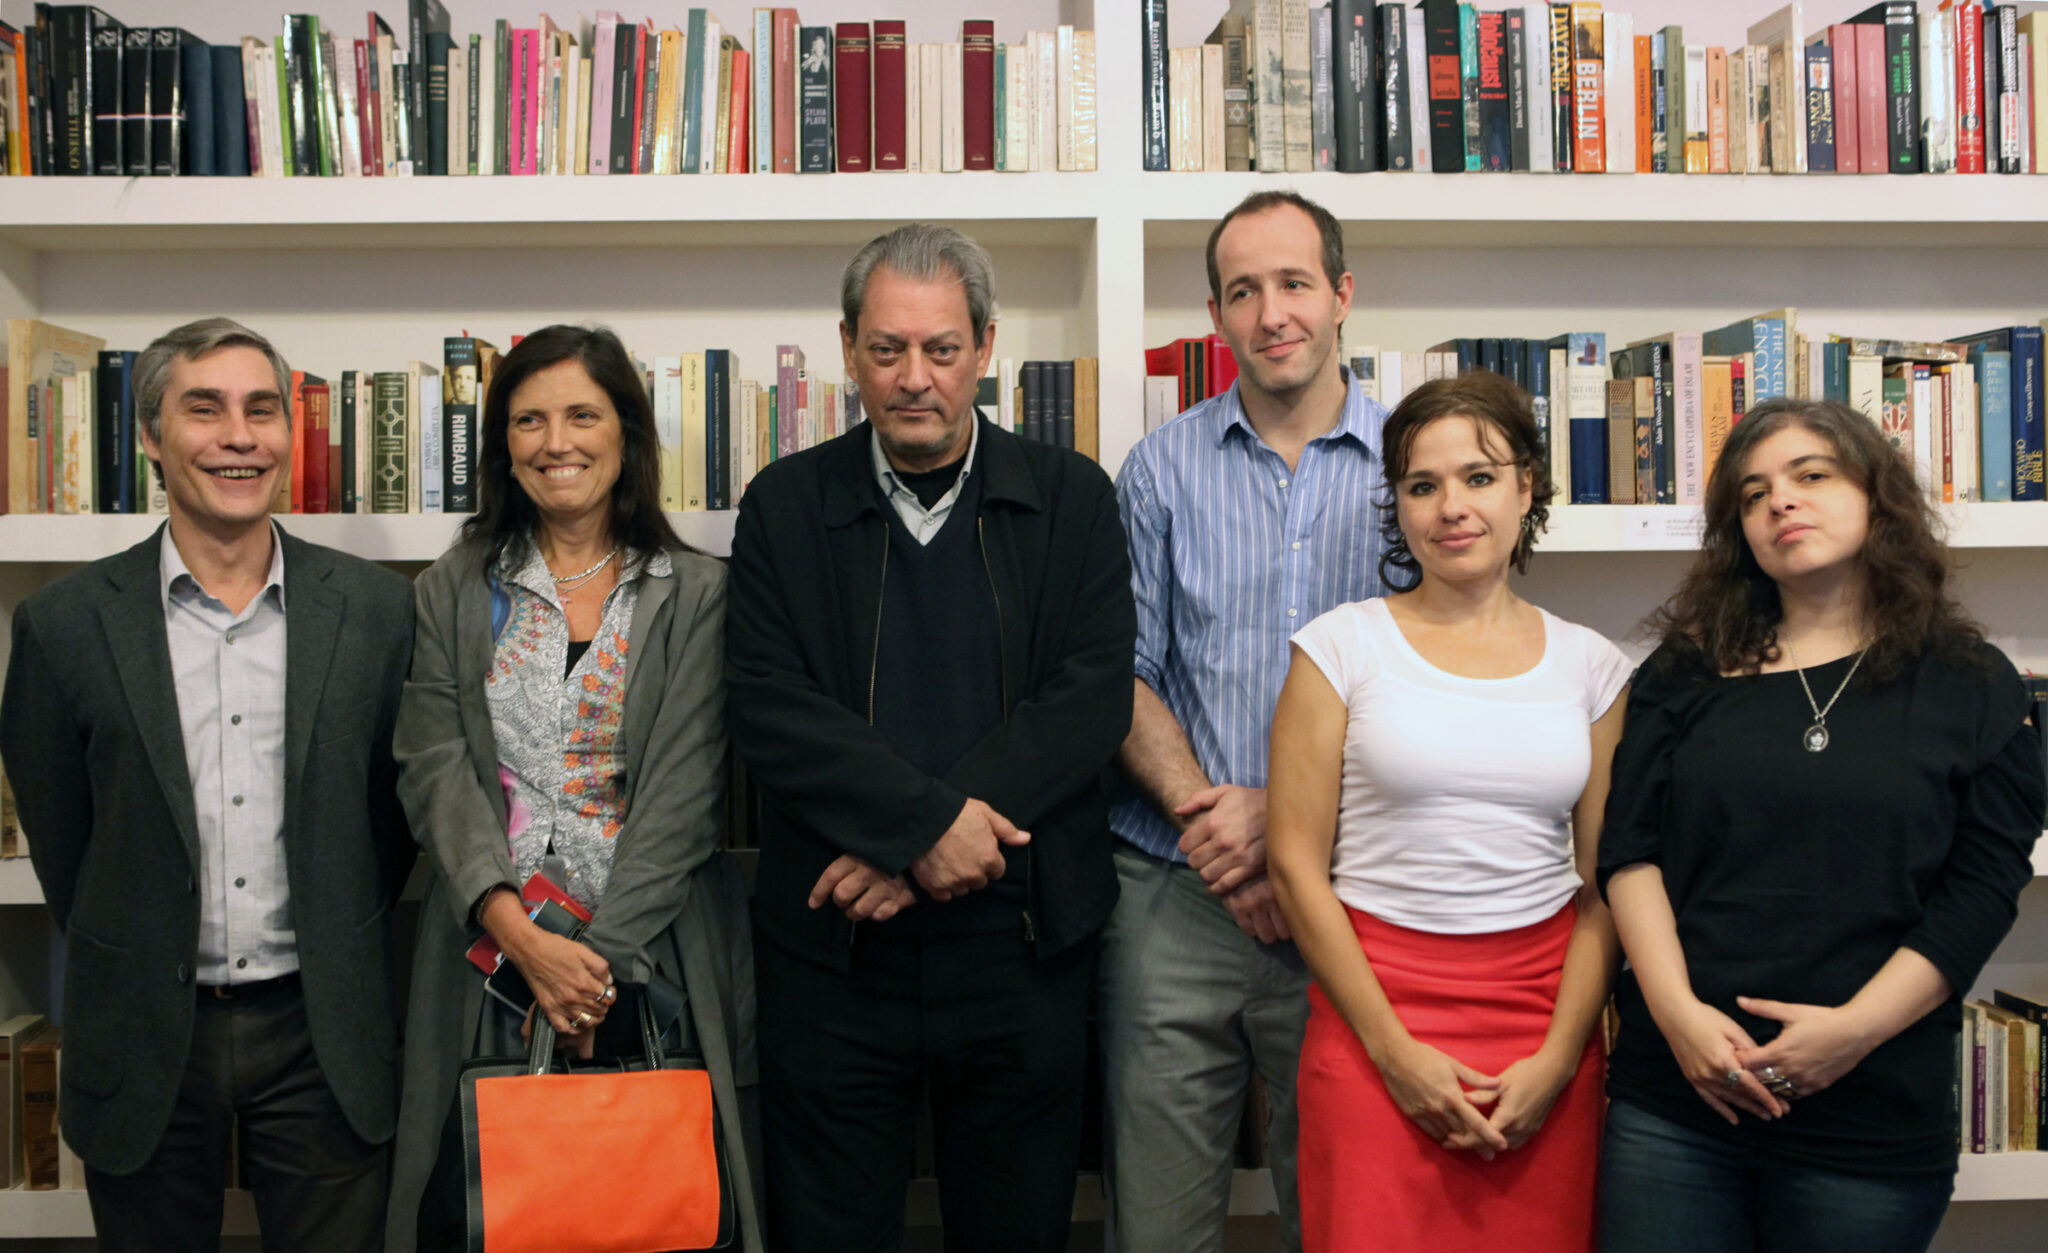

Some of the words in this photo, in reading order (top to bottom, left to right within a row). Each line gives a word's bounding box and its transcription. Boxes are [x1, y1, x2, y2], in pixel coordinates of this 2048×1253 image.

[1316, 17, 1327, 57] humano
[1551, 8, 1570, 46] DAY
[1902, 33, 1910, 47] THE
[1152, 21, 1161, 87] Brotherhood
[1229, 40, 1242, 86] TREBLINKA
[1479, 13, 1506, 88] Holocaust
[1892, 54, 1899, 65] OF
[759, 51, 769, 85] PLATH
[1551, 46, 1570, 92] ONE
[1893, 68, 1902, 94] POWER
[804, 108, 827, 116] SYLVIA
[1575, 62, 1599, 139] BERLIN
[804, 117, 827, 125] PLATH
[1152, 102, 1161, 139] Bomb
[69, 113, 80, 170] O'NEILL
[1773, 324, 1784, 355] THE
[1684, 363, 1693, 388] ISLAM
[1773, 359, 1783, 396] NEW
[1685, 389, 1693, 400] OF
[1685, 400, 1695, 459] ENCYCLOPEDIA
[452, 414, 467, 486] RIMBAUD
[2016, 439, 2025, 463] WHO
[2025, 453, 2034, 470] THE
[1686, 462, 1695, 478] NEW
[2016, 464, 2026, 495] WHO'S
[2026, 470, 2034, 481] IN
[2033, 450, 2043, 483] BIBLE
[1686, 483, 1696, 497] THE
